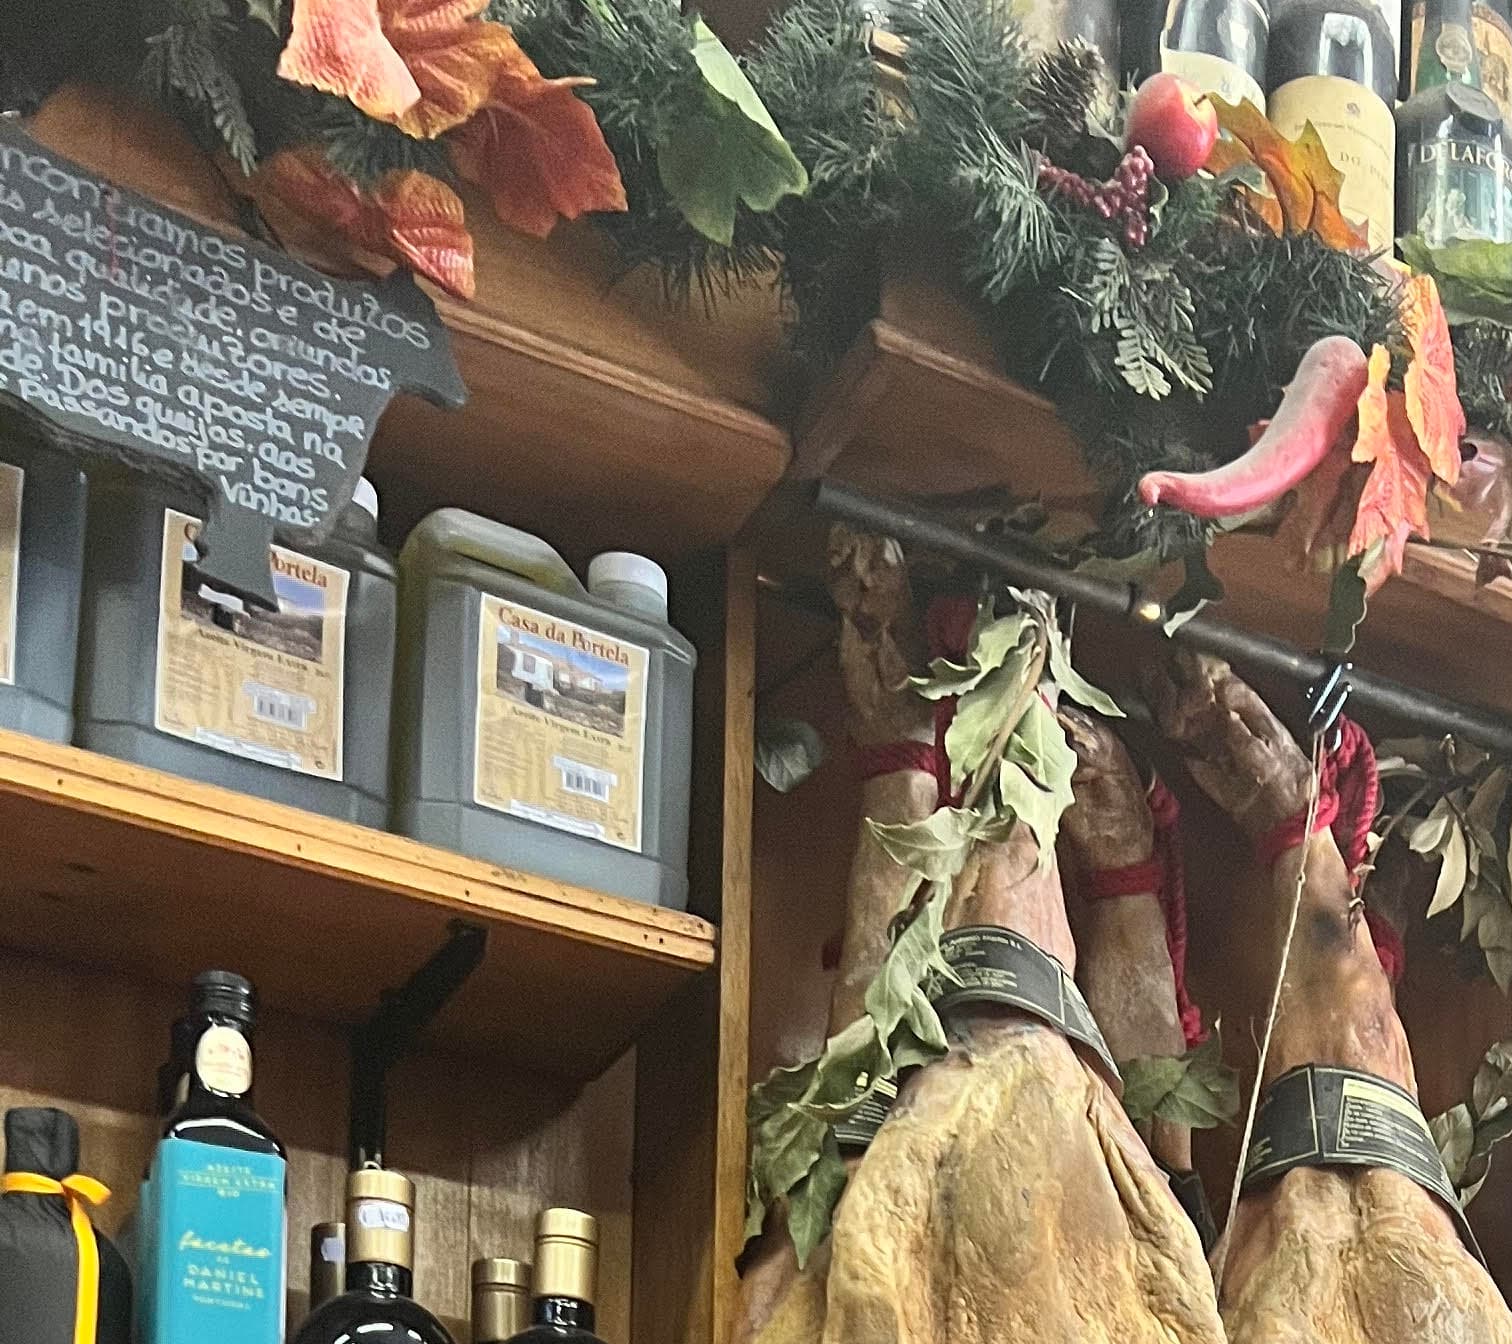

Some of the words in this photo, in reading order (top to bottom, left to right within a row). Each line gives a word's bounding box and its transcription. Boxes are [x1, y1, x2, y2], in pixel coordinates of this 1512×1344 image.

[498, 606, 540, 635] Casa
[544, 622, 567, 644] da
[572, 629, 631, 667] Portela
[186, 1263, 261, 1287] DANIEL
